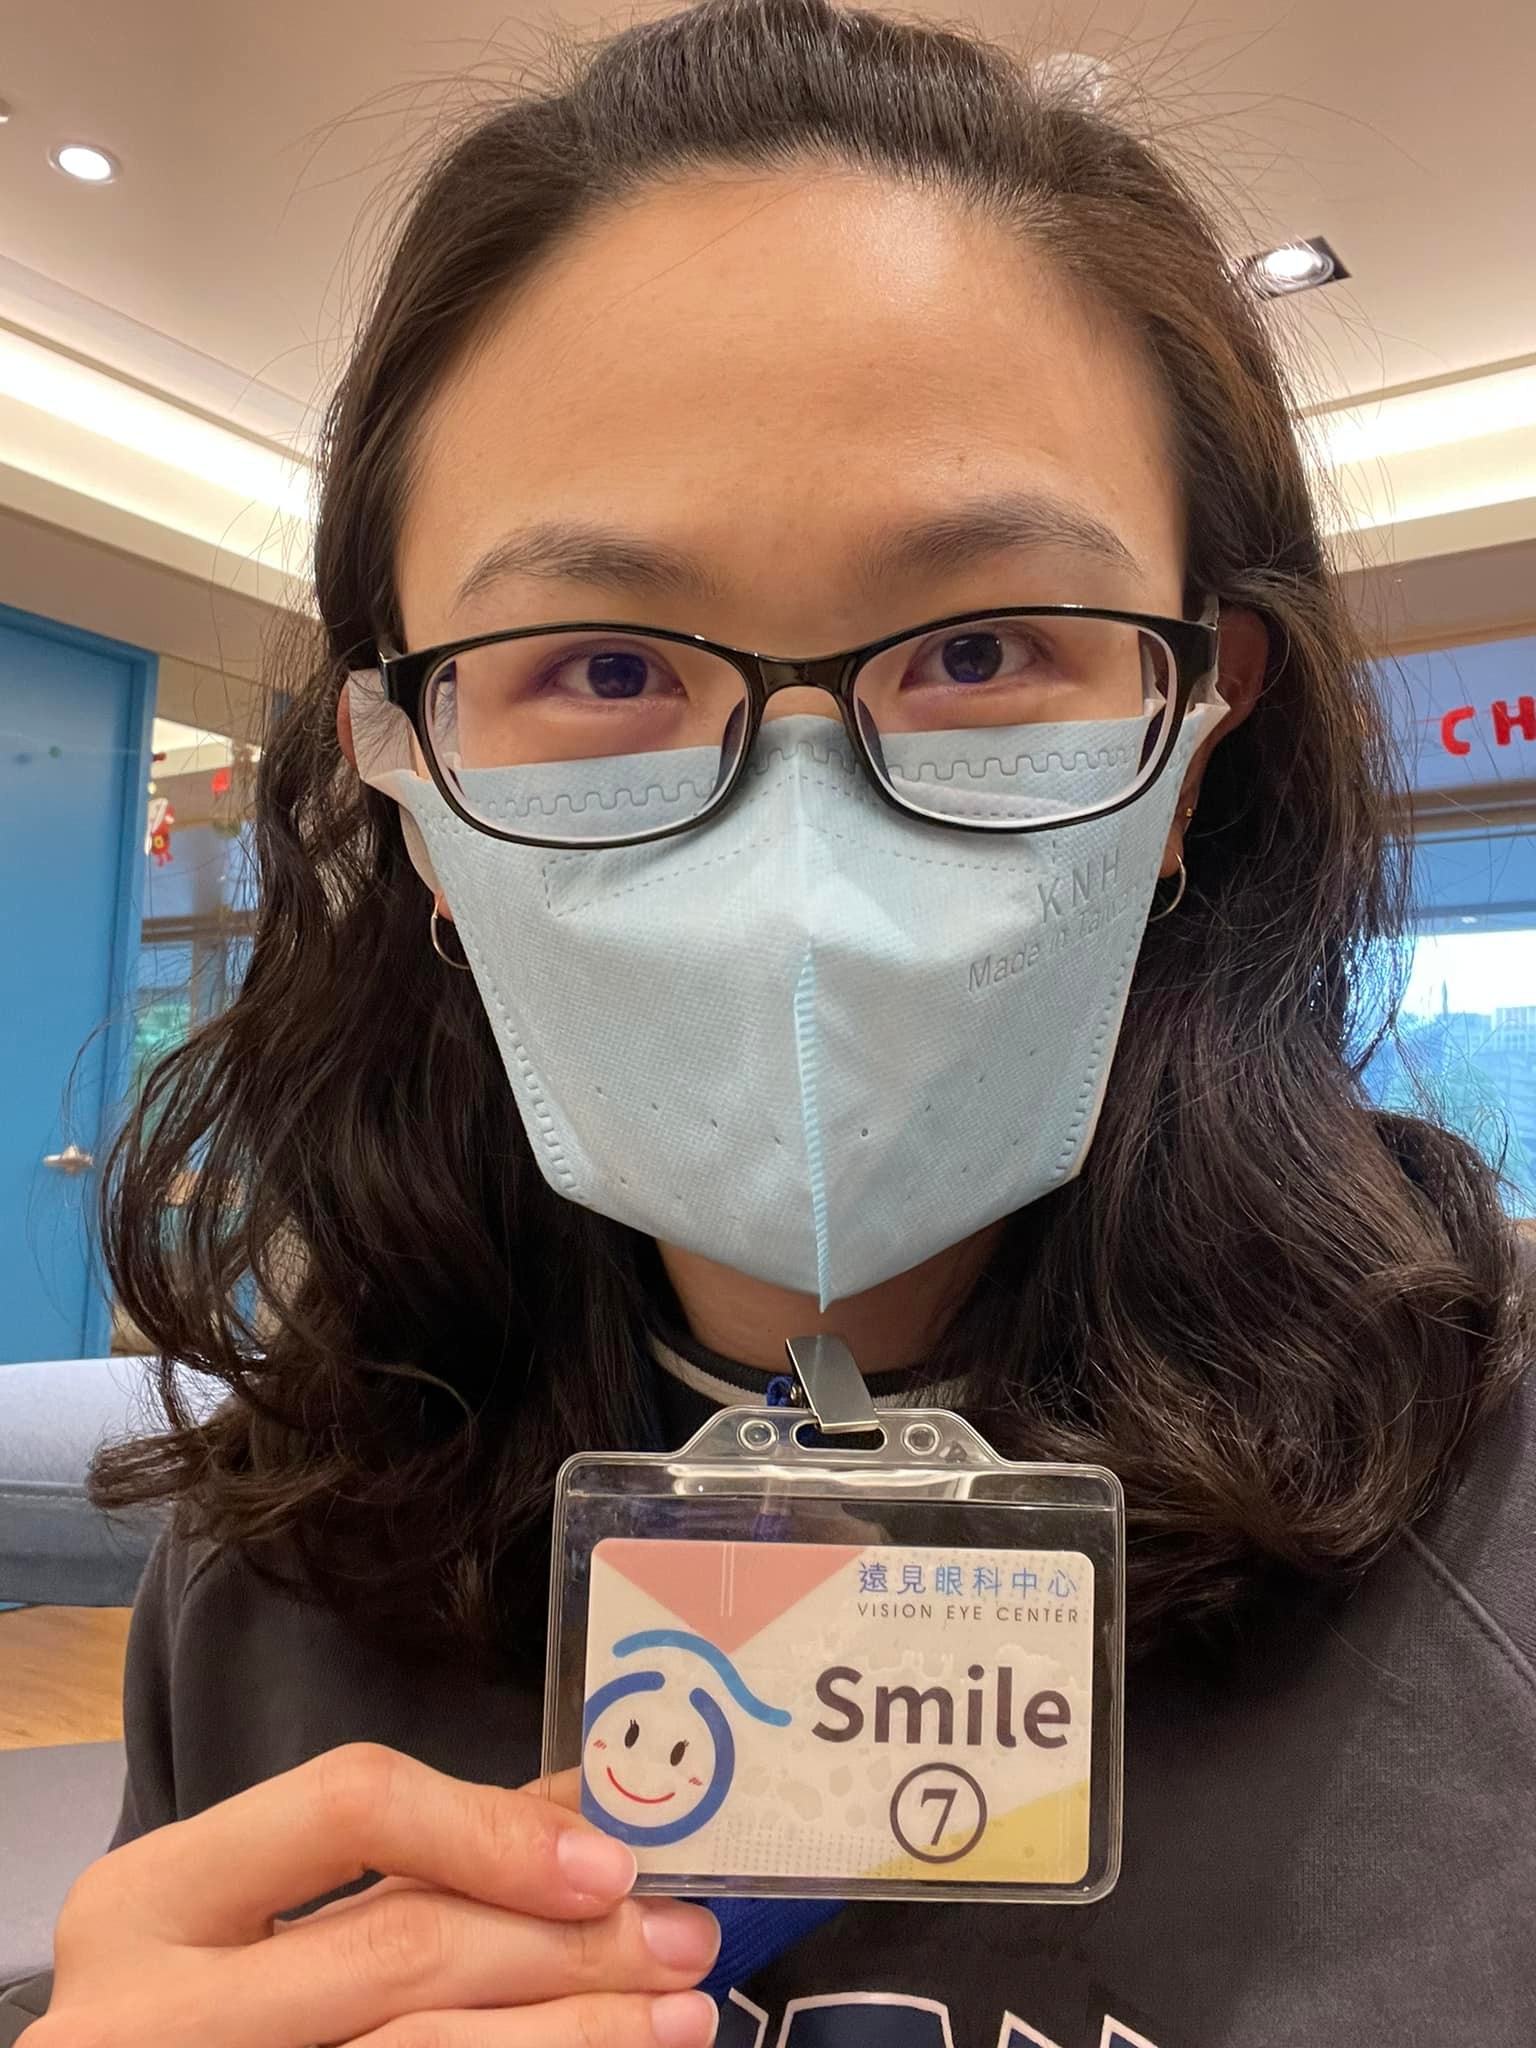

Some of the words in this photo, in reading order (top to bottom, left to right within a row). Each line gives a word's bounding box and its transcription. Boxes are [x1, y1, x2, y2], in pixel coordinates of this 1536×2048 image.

[1440, 695, 1536, 757] CH
[1036, 847, 1119, 924] KNH
[968, 943, 1041, 993] Made
[858, 1560, 1078, 1600] 遠見眼科中心
[857, 1602, 933, 1620] VISION
[946, 1604, 982, 1621] EYE
[996, 1606, 1079, 1624] CENTER
[811, 1664, 1072, 1749] Smile
[919, 1787, 958, 1847] 7
